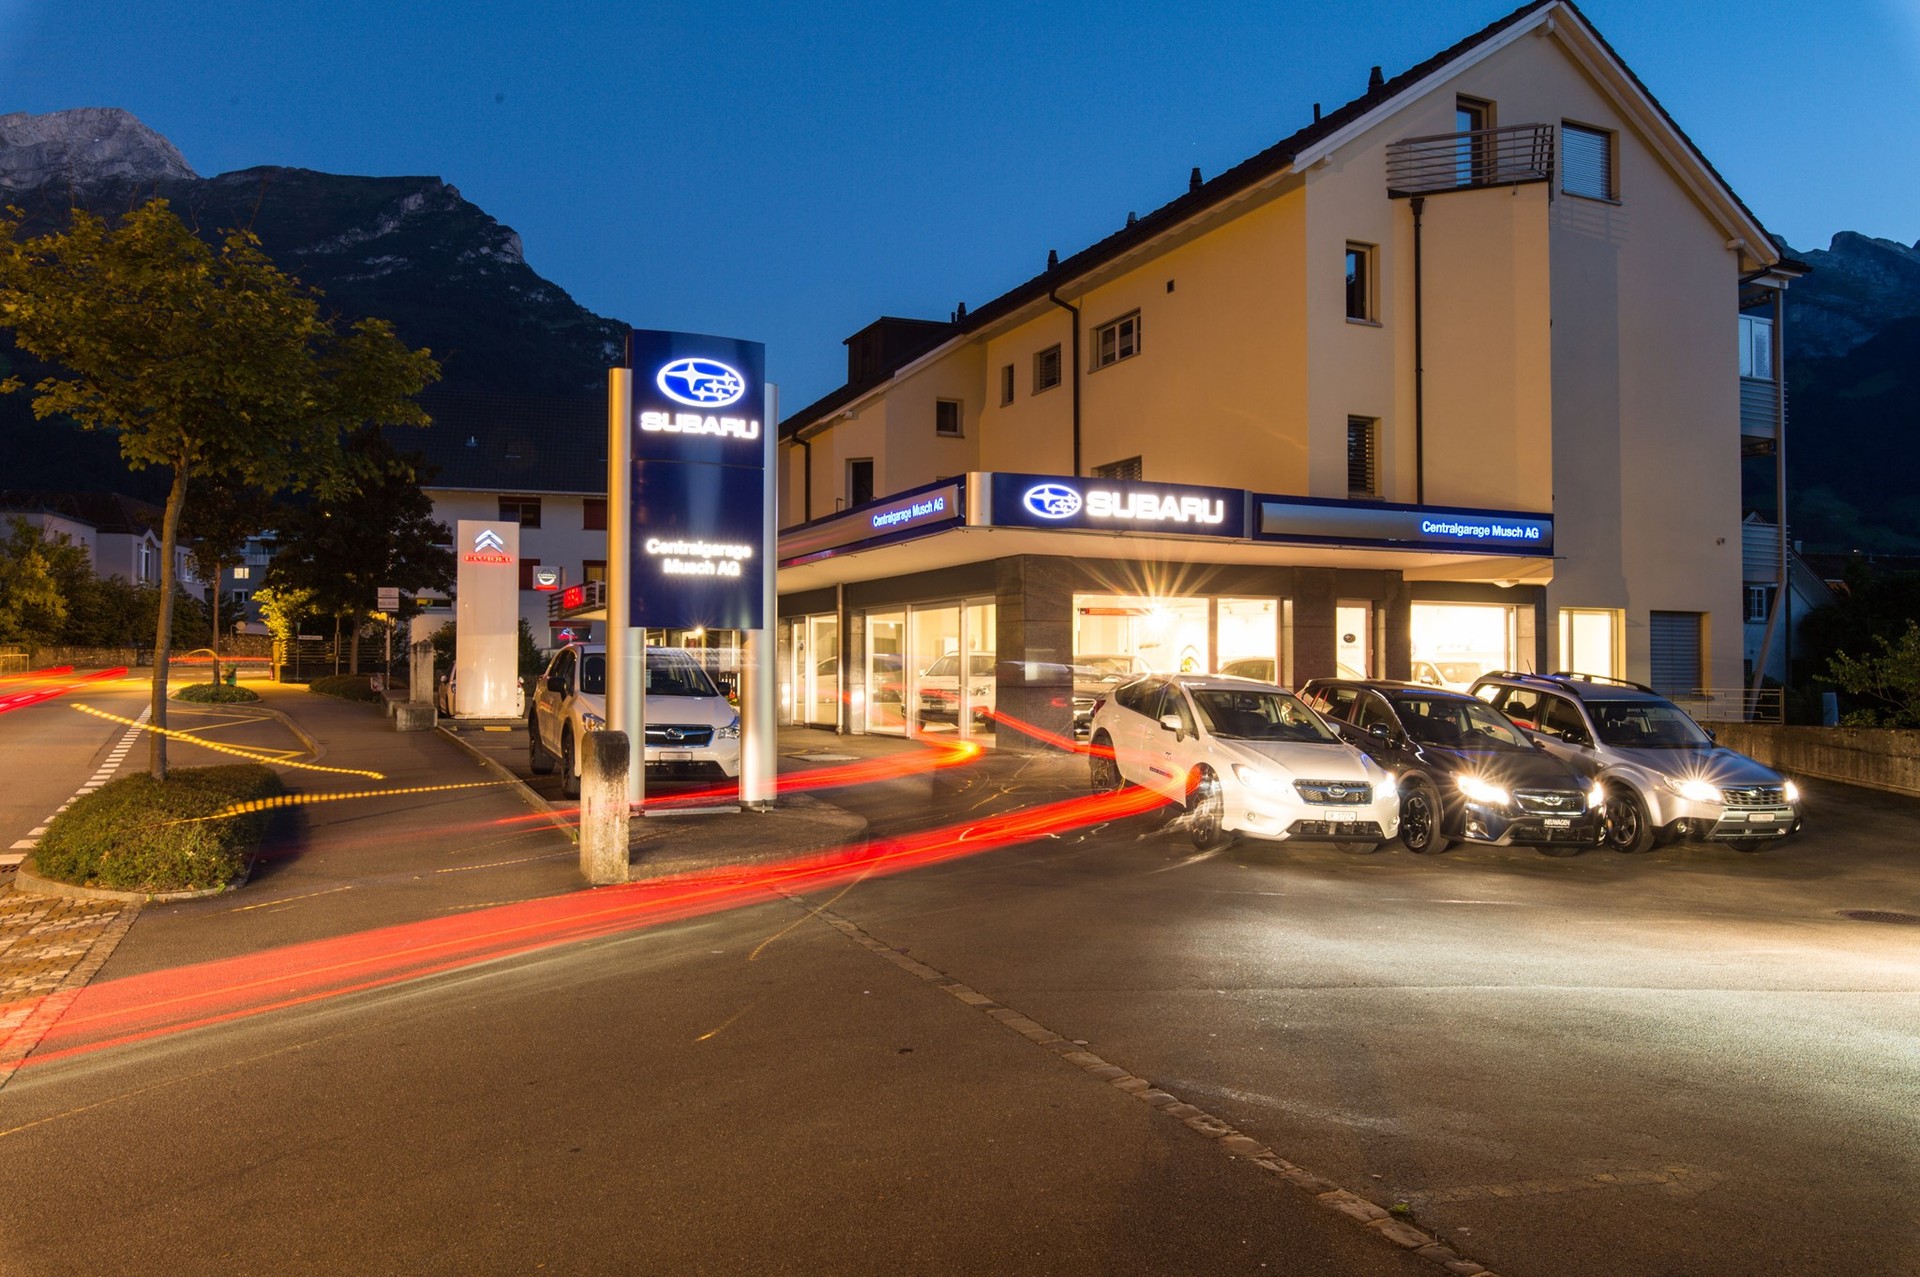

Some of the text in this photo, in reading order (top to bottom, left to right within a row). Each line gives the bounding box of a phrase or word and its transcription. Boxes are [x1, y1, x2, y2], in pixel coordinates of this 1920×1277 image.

[640, 411, 760, 439] SUBARU
[872, 497, 944, 527] Centralgarage Musch AG
[1086, 490, 1225, 524] SUBARU
[1422, 520, 1539, 539] Centralgarage Musch AG
[645, 538, 753, 560] Centralgarage
[663, 558, 742, 577] Musch AG
